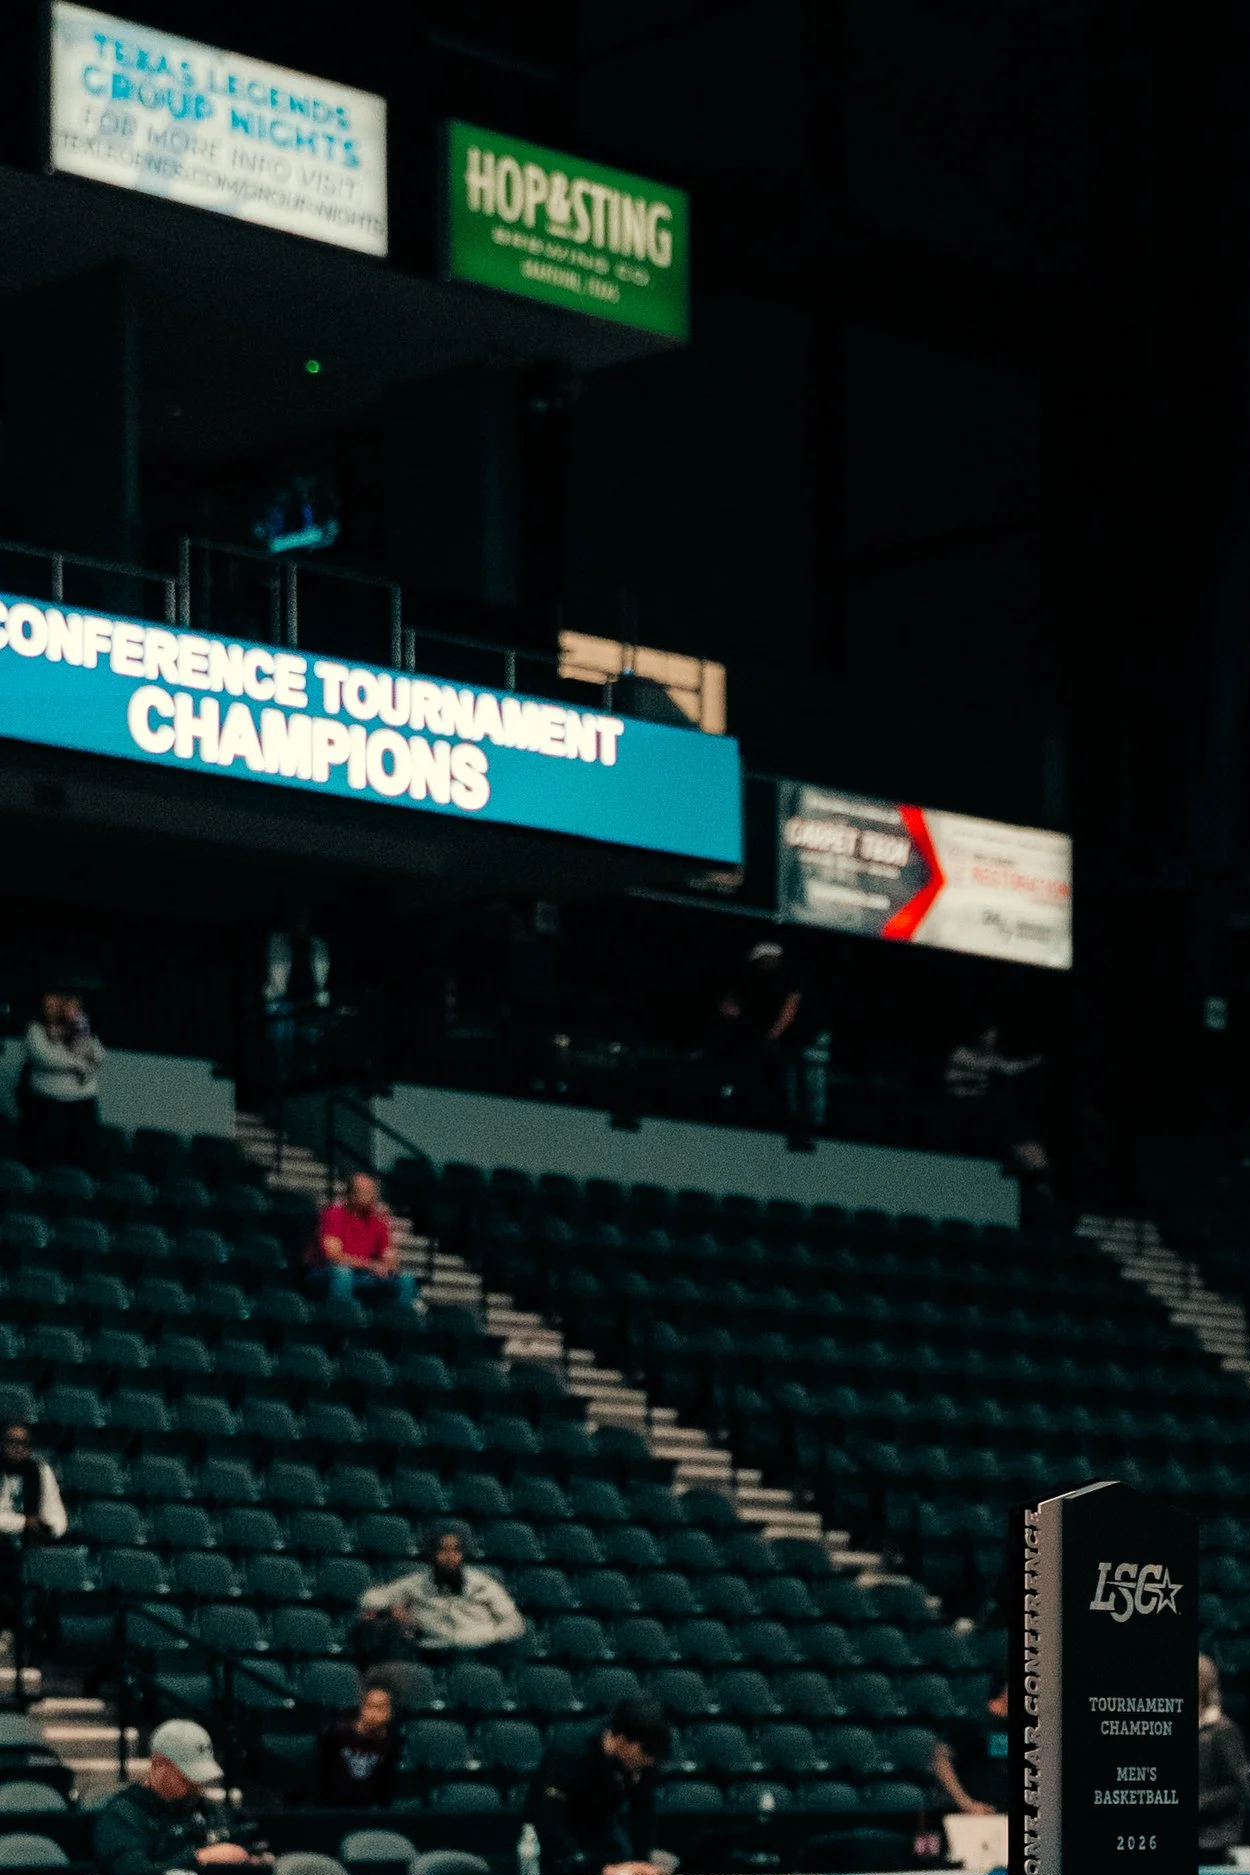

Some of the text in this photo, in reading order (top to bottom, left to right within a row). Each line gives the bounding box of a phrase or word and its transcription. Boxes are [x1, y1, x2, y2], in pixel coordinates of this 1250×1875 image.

[82, 63, 363, 171] GROUP NIGHTS
[93, 31, 353, 132] TEXAS LEGENDS
[0, 600, 624, 766] ONFERENCE TOURNAMENT
[127, 684, 491, 812] CHAMPIONS
[1023, 1509, 1042, 1717] CONFERENCE
[1089, 1562, 1163, 1623] LSC
[1089, 1696, 1184, 1714] TOURNAMENT
[1100, 1720, 1173, 1737] CHAMPION
[1023, 1725, 1041, 1807] STAR
[1094, 1789, 1179, 1805] BASKETBALL
[1116, 1766, 1158, 1783] MEN'S
[1116, 1836, 1158, 1851] 2026
